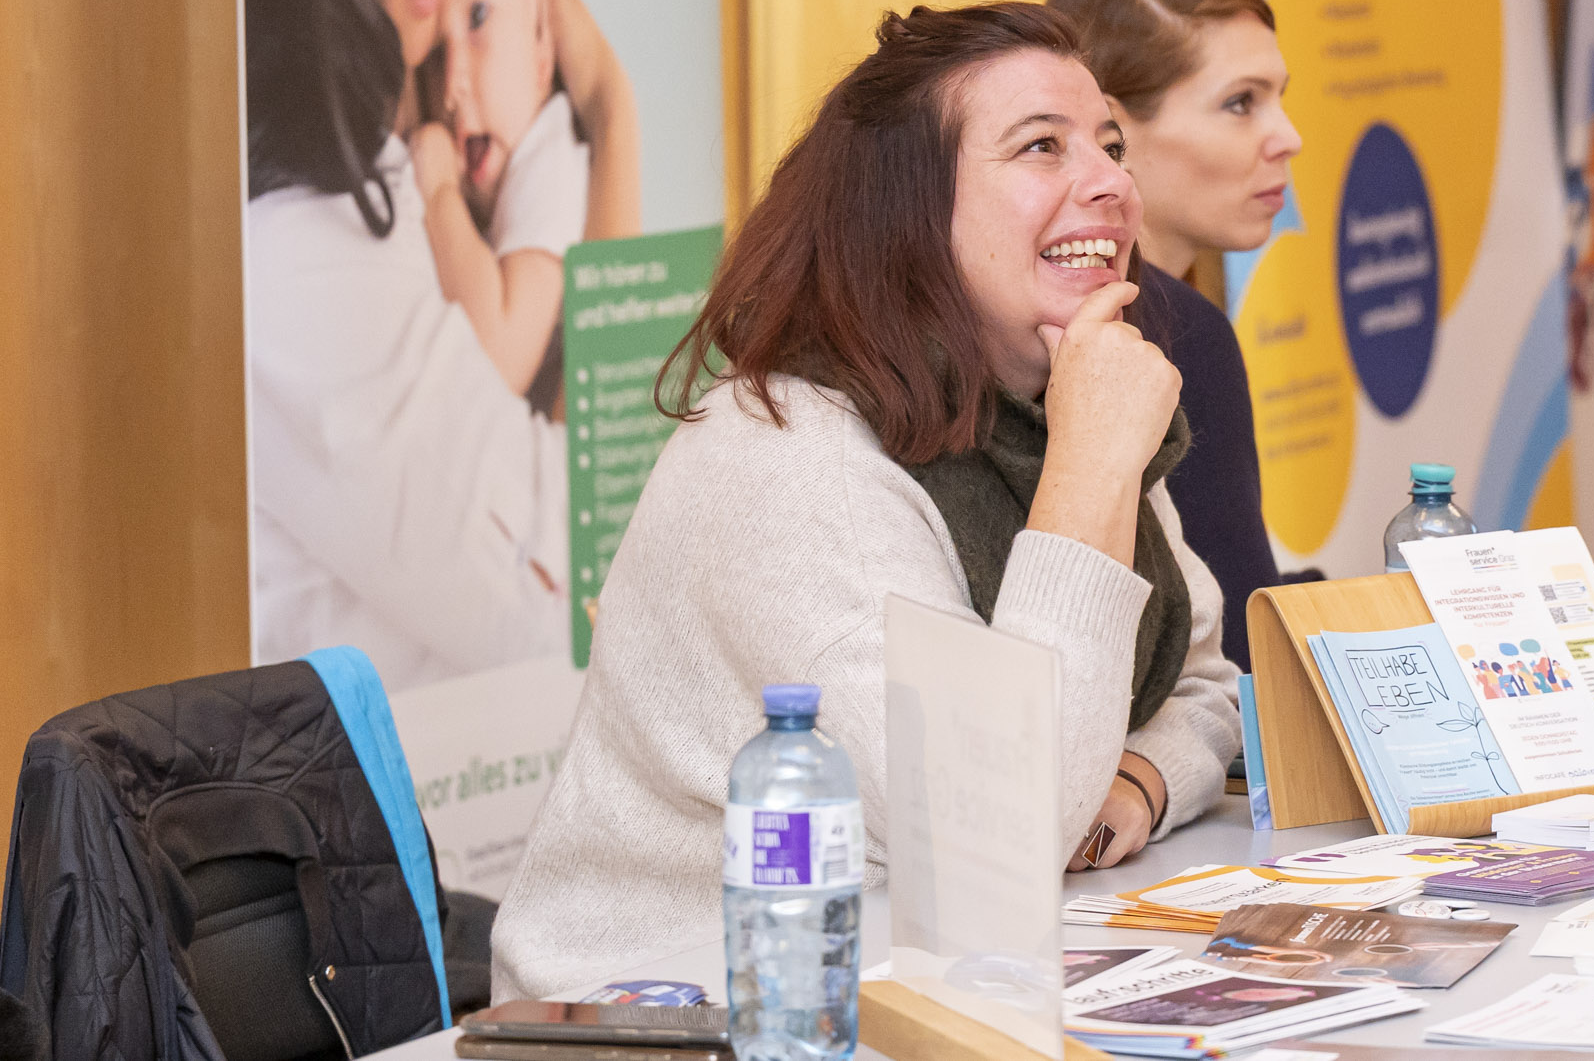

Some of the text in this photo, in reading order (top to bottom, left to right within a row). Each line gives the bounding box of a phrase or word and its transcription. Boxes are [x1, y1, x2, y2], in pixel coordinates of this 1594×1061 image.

[1469, 555, 1498, 566] service
[1450, 587, 1487, 596] LEHRGANG
[1434, 591, 1526, 606] INTEGRATIONSWISSEN UND
[1453, 601, 1515, 613] INTERKULTURELLE
[1463, 610, 1514, 621] KOMPETENZEN
[1349, 653, 1428, 680] TEILHABE
[1367, 680, 1450, 708] LEBEN
[457, 754, 506, 802] alles
[512, 753, 542, 786] zu
